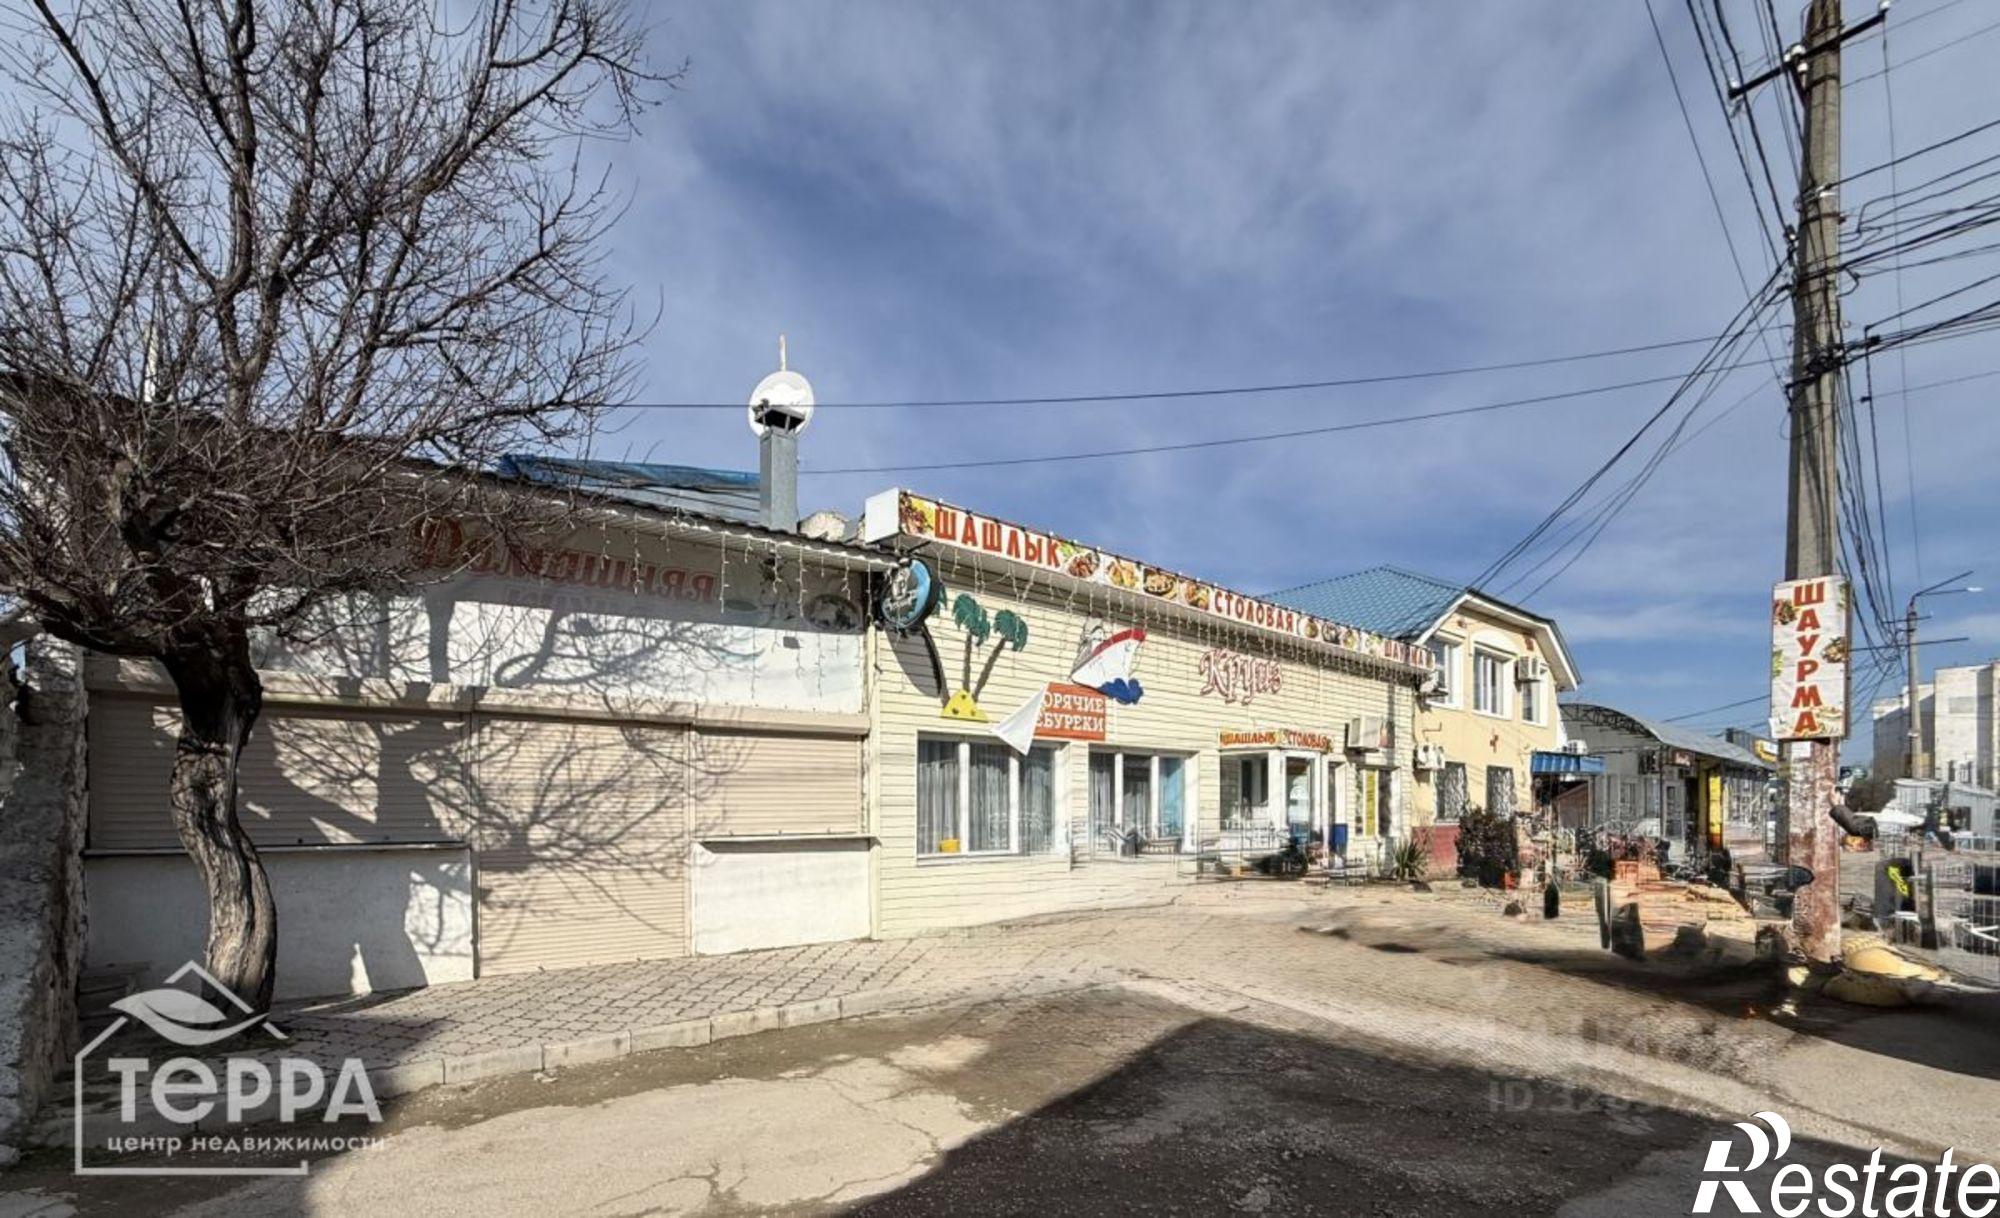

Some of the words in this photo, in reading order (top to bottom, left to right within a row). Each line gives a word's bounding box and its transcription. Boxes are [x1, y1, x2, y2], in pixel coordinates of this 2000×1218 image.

[933, 508, 1061, 569] ШАШЛЫК
[1214, 591, 1294, 633] СТОЛОВАЯ
[1791, 582, 1825, 733] ШАУРМА
[1035, 711, 1104, 732] ЕБУРЕКИ
[1043, 691, 1104, 713] ОРЯЧИЕ
